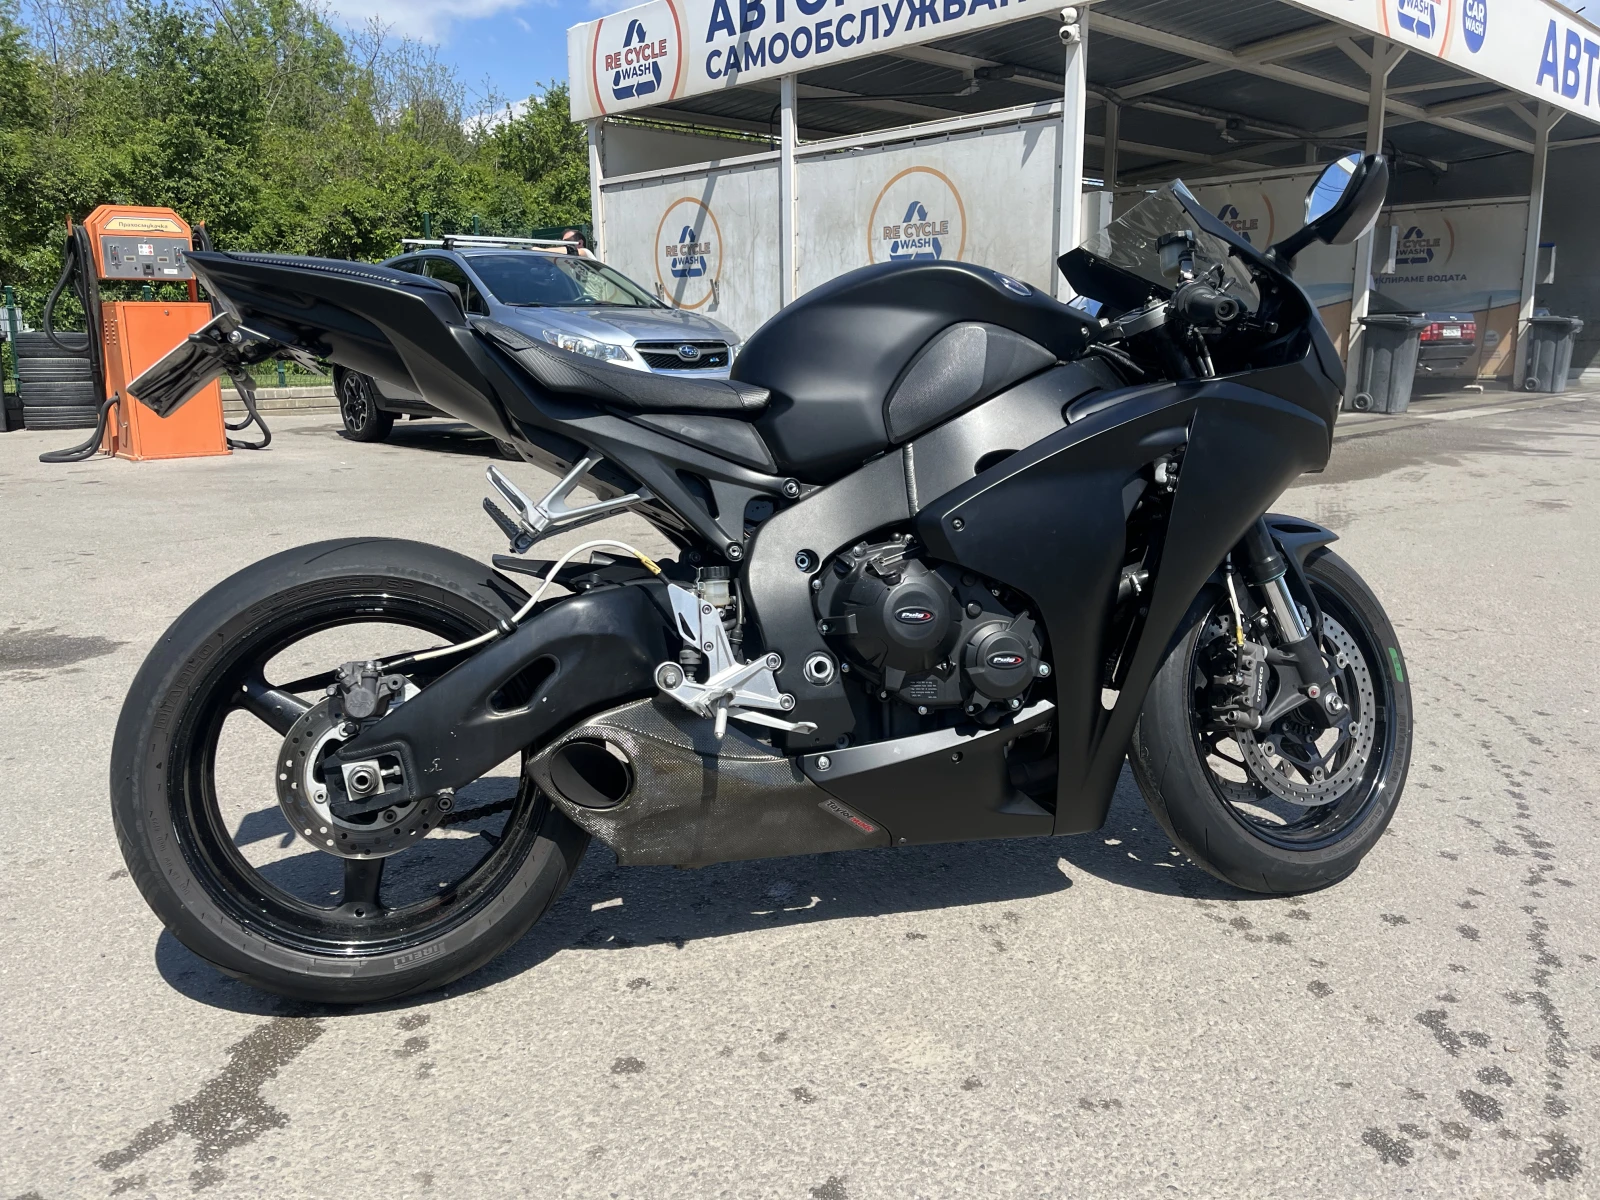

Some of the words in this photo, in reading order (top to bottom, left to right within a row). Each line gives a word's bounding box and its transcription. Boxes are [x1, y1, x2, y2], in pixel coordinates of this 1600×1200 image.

[1466, 1, 1485, 22] CAR
[1465, 16, 1484, 36] WASH
[705, 0, 1027, 79] САМООБСЛУЖВА
[605, 52, 622, 71] RE
[624, 39, 667, 64] CYCLE
[1535, 18, 1600, 108] АВТ
[621, 65, 651, 80] WASH
[883, 225, 900, 240] RE
[904, 220, 949, 238] CYCLE
[665, 245, 678, 257] RE
[680, 242, 711, 256] CYCLE
[900, 237, 931, 249] WASH
[1403, 238, 1441, 248] CYCLE
[1400, 248, 1425, 256] WASH
[678, 256, 699, 266] WASH
[1427, 274, 1467, 283] ВОДАТА
